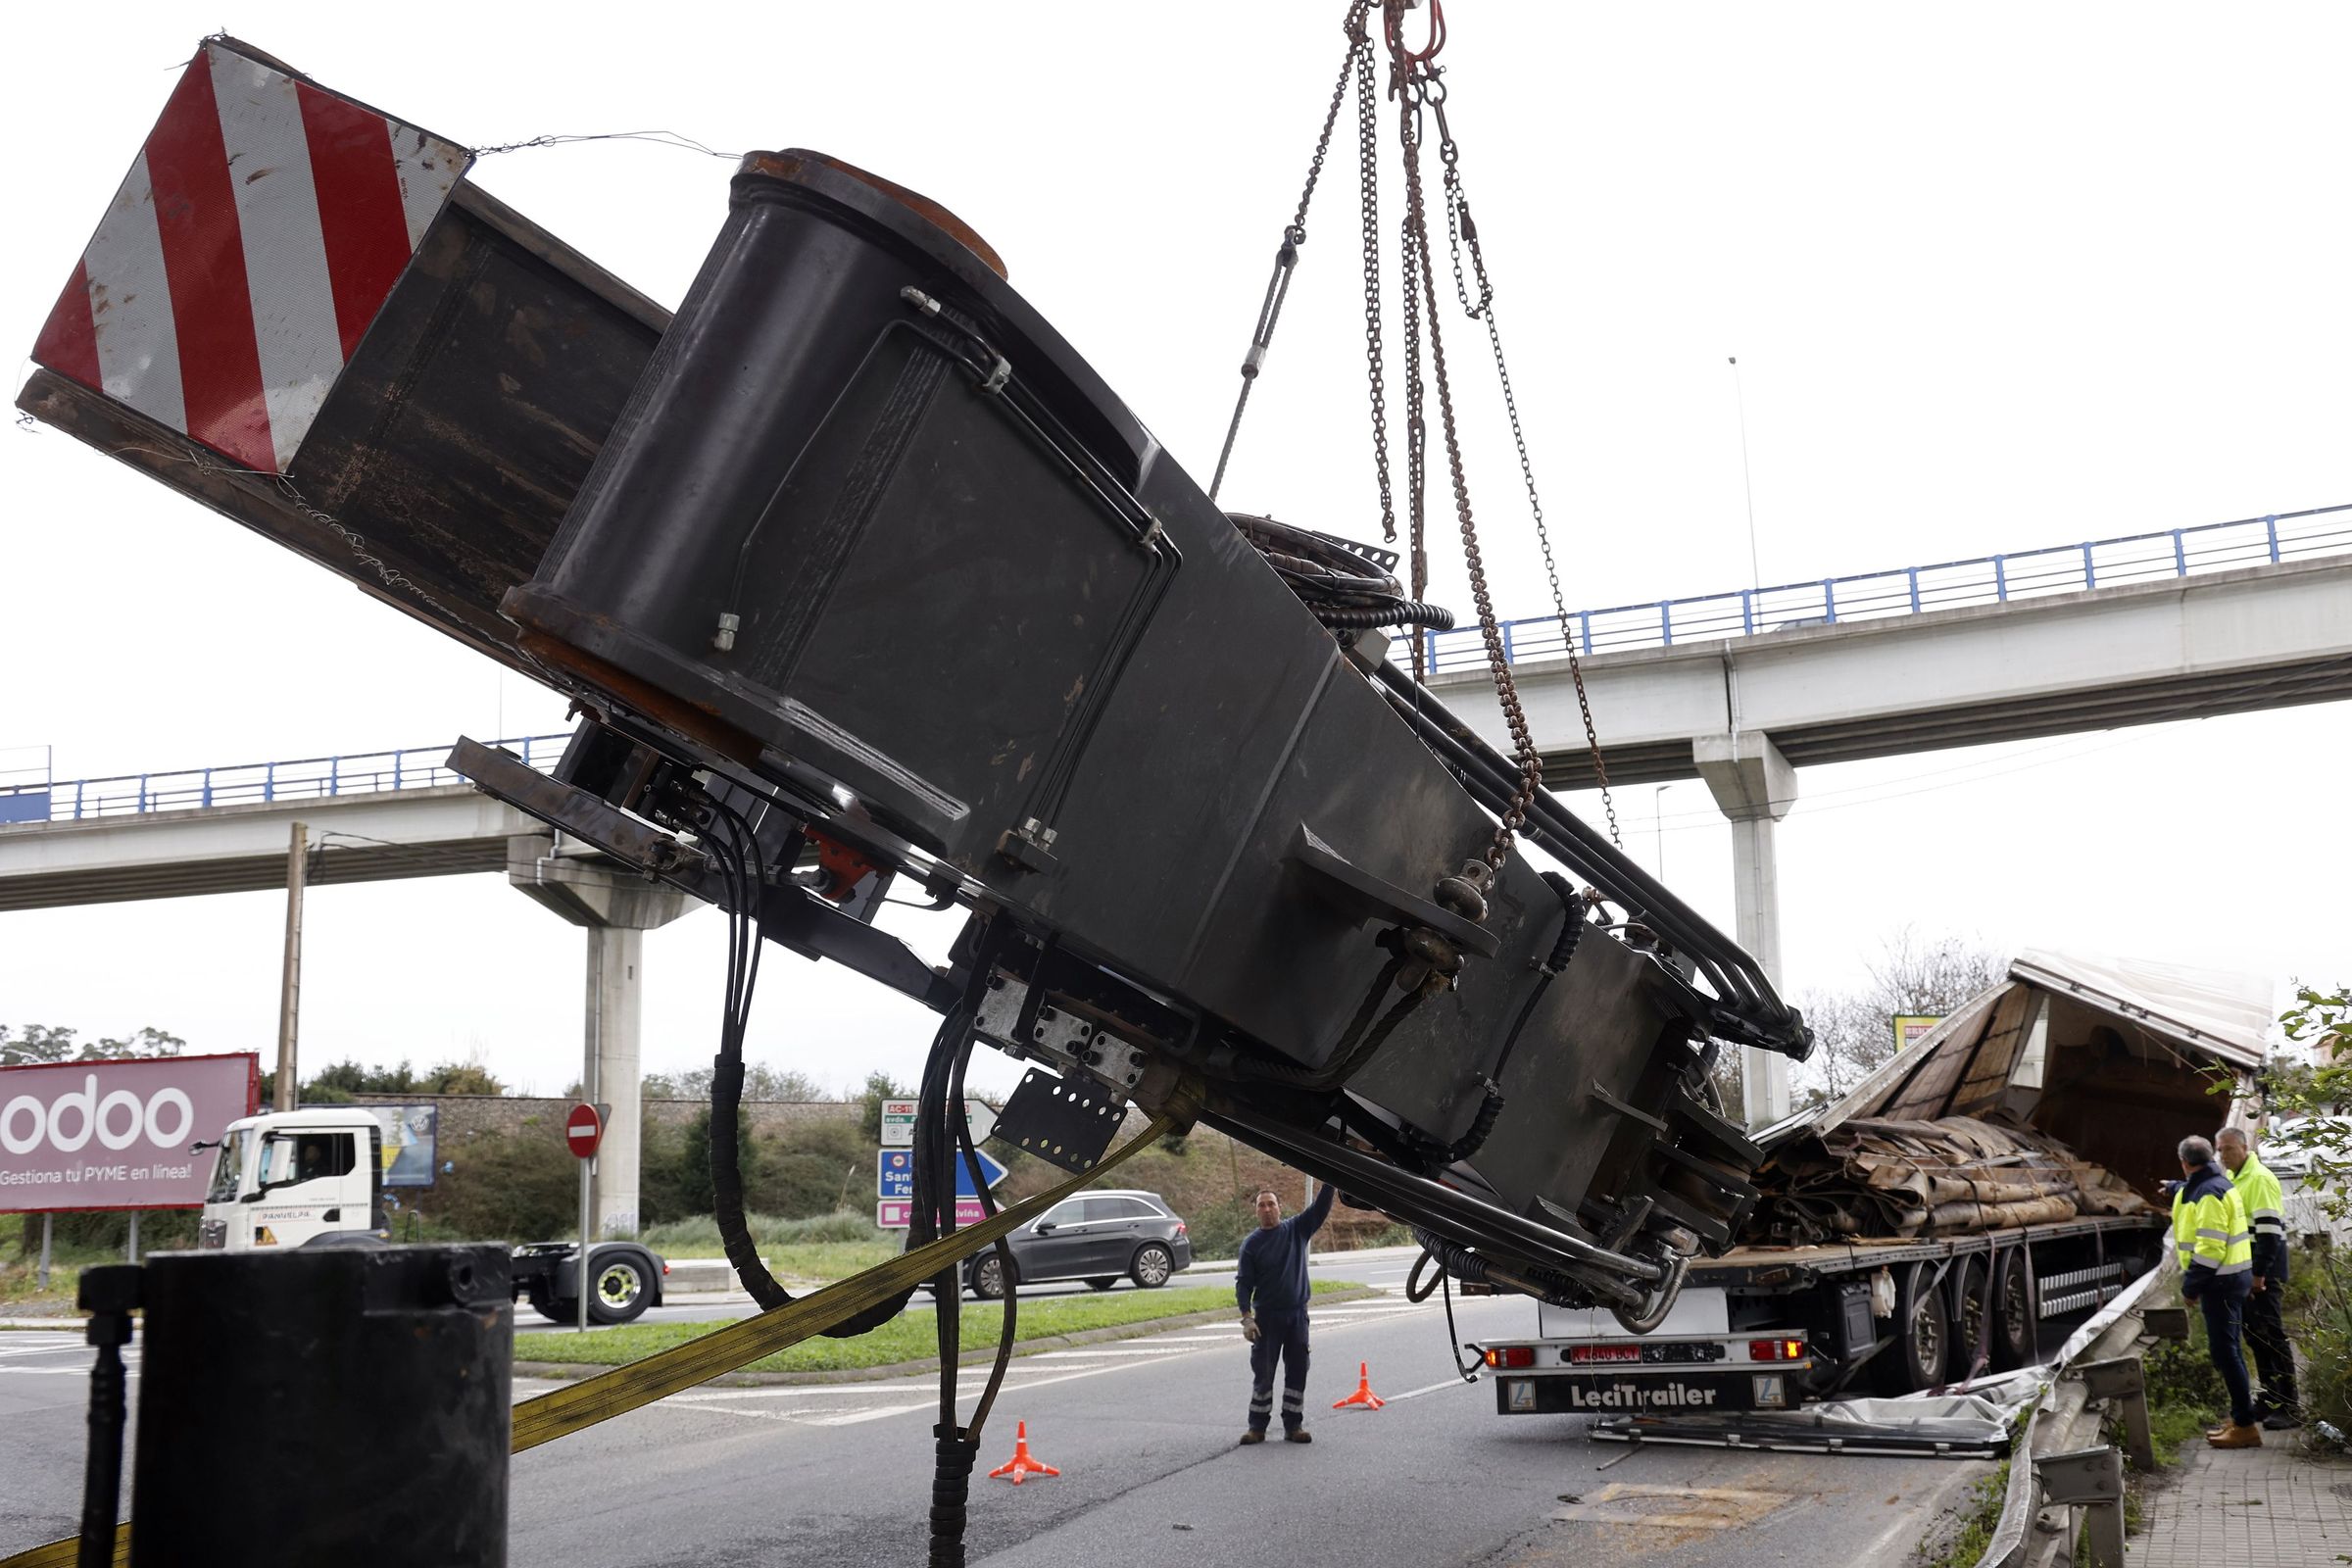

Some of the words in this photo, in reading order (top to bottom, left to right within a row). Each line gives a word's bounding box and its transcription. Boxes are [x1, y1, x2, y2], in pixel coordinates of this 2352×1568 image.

[0, 1073, 194, 1154] odoo
[0, 1169, 63, 1185] Gestiona
[66, 1169, 80, 1183] tu
[84, 1165, 127, 1182] PYME
[130, 1168, 149, 1181] en
[152, 1163, 193, 1180] línea!
[1571, 1383, 1717, 1407] LeciTrailer
